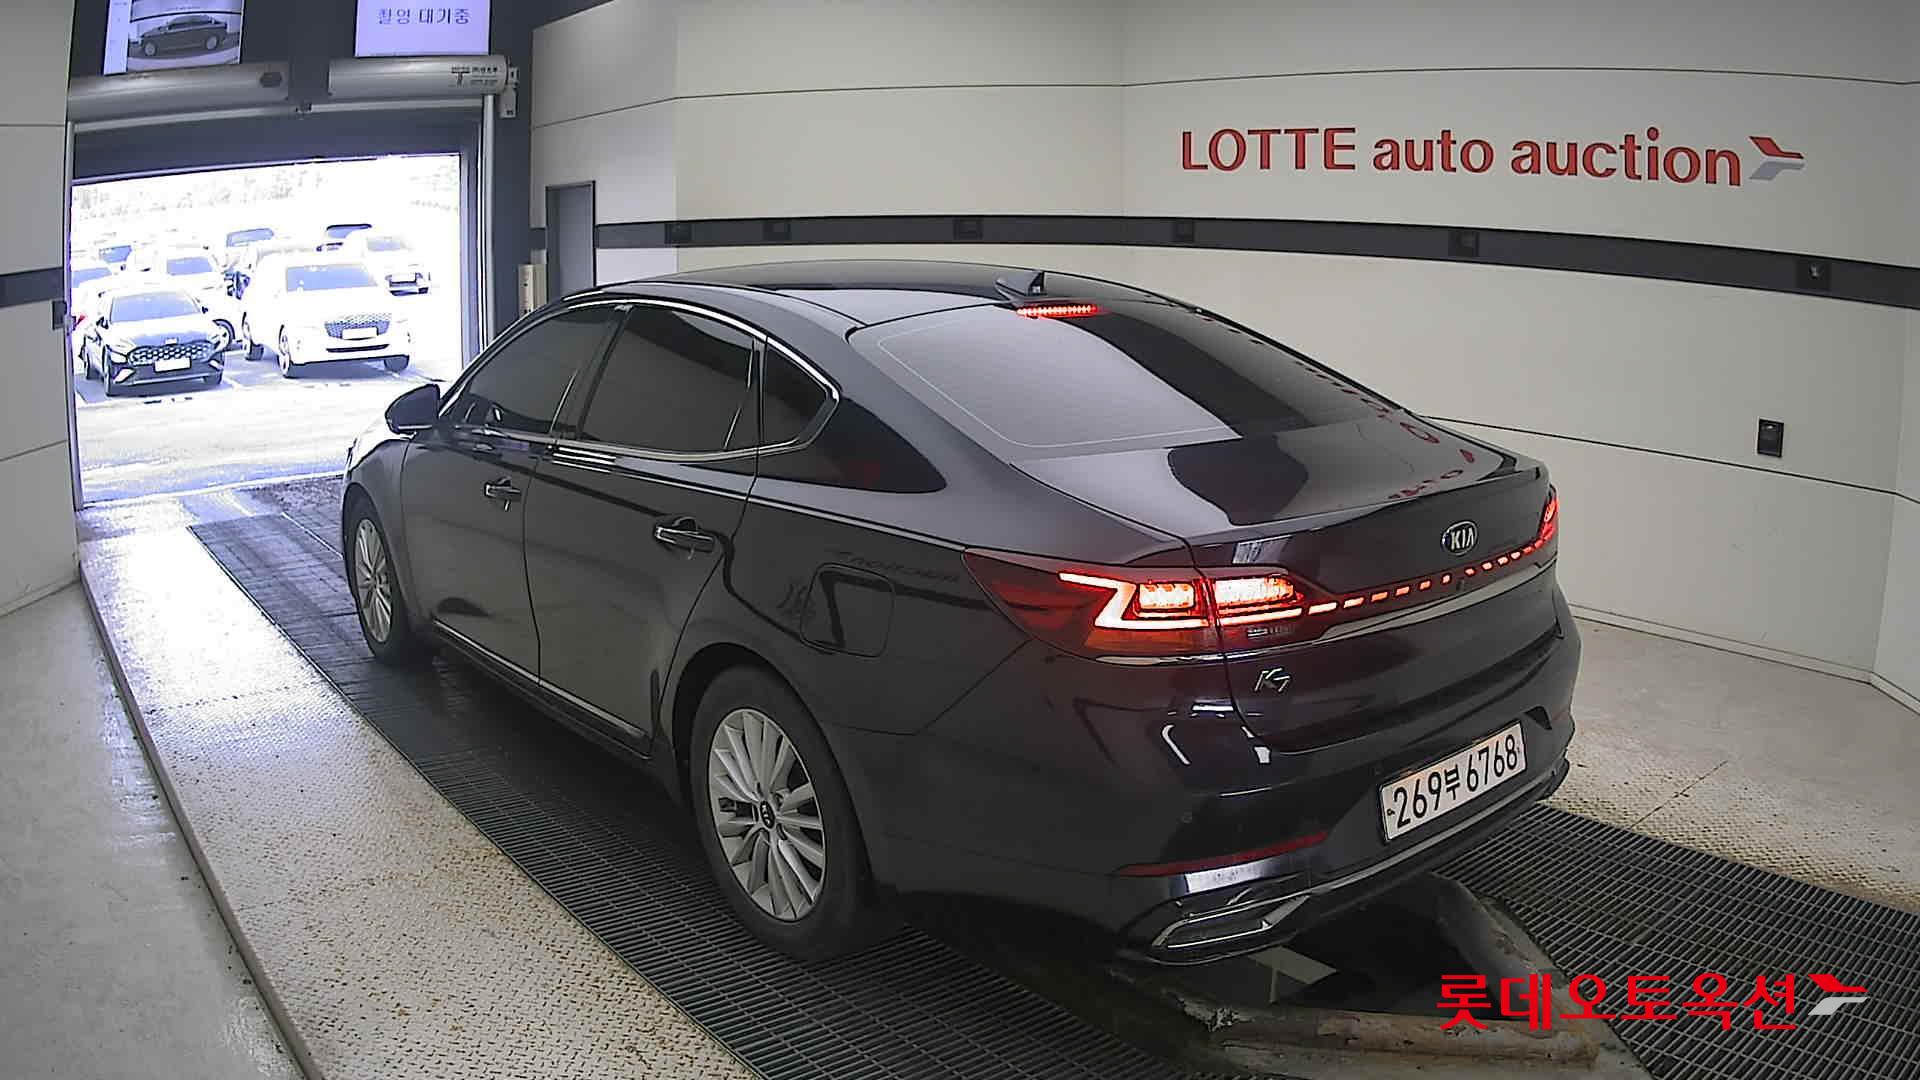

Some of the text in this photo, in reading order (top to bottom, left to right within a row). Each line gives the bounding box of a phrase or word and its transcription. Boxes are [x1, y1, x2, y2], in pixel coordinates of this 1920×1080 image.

[418, 8, 471, 24] 대기중
[1181, 127, 1743, 187] LOTTE auto auction
[1450, 526, 1475, 551] KIA
[1253, 667, 1291, 692] K7
[1393, 734, 1518, 829] 269부6768
